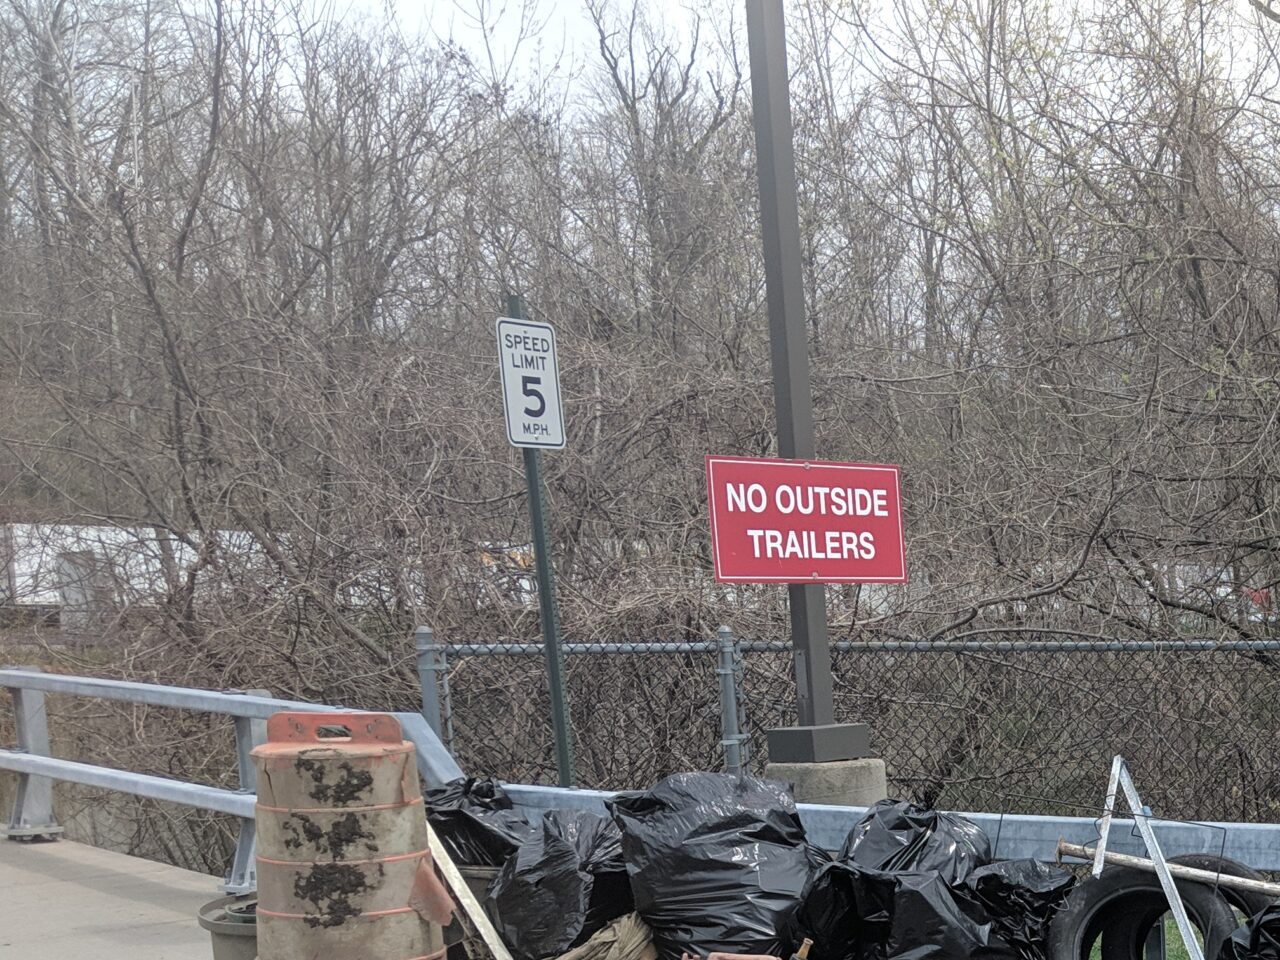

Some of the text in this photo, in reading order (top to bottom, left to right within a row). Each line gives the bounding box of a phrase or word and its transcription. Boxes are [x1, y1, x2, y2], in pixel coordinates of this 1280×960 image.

[505, 333, 550, 353] SPEED
[511, 353, 546, 371] LIMIT
[521, 375, 545, 418] 5
[726, 483, 889, 517] NO OUTSIDE
[747, 529, 876, 560] TRAILERS
